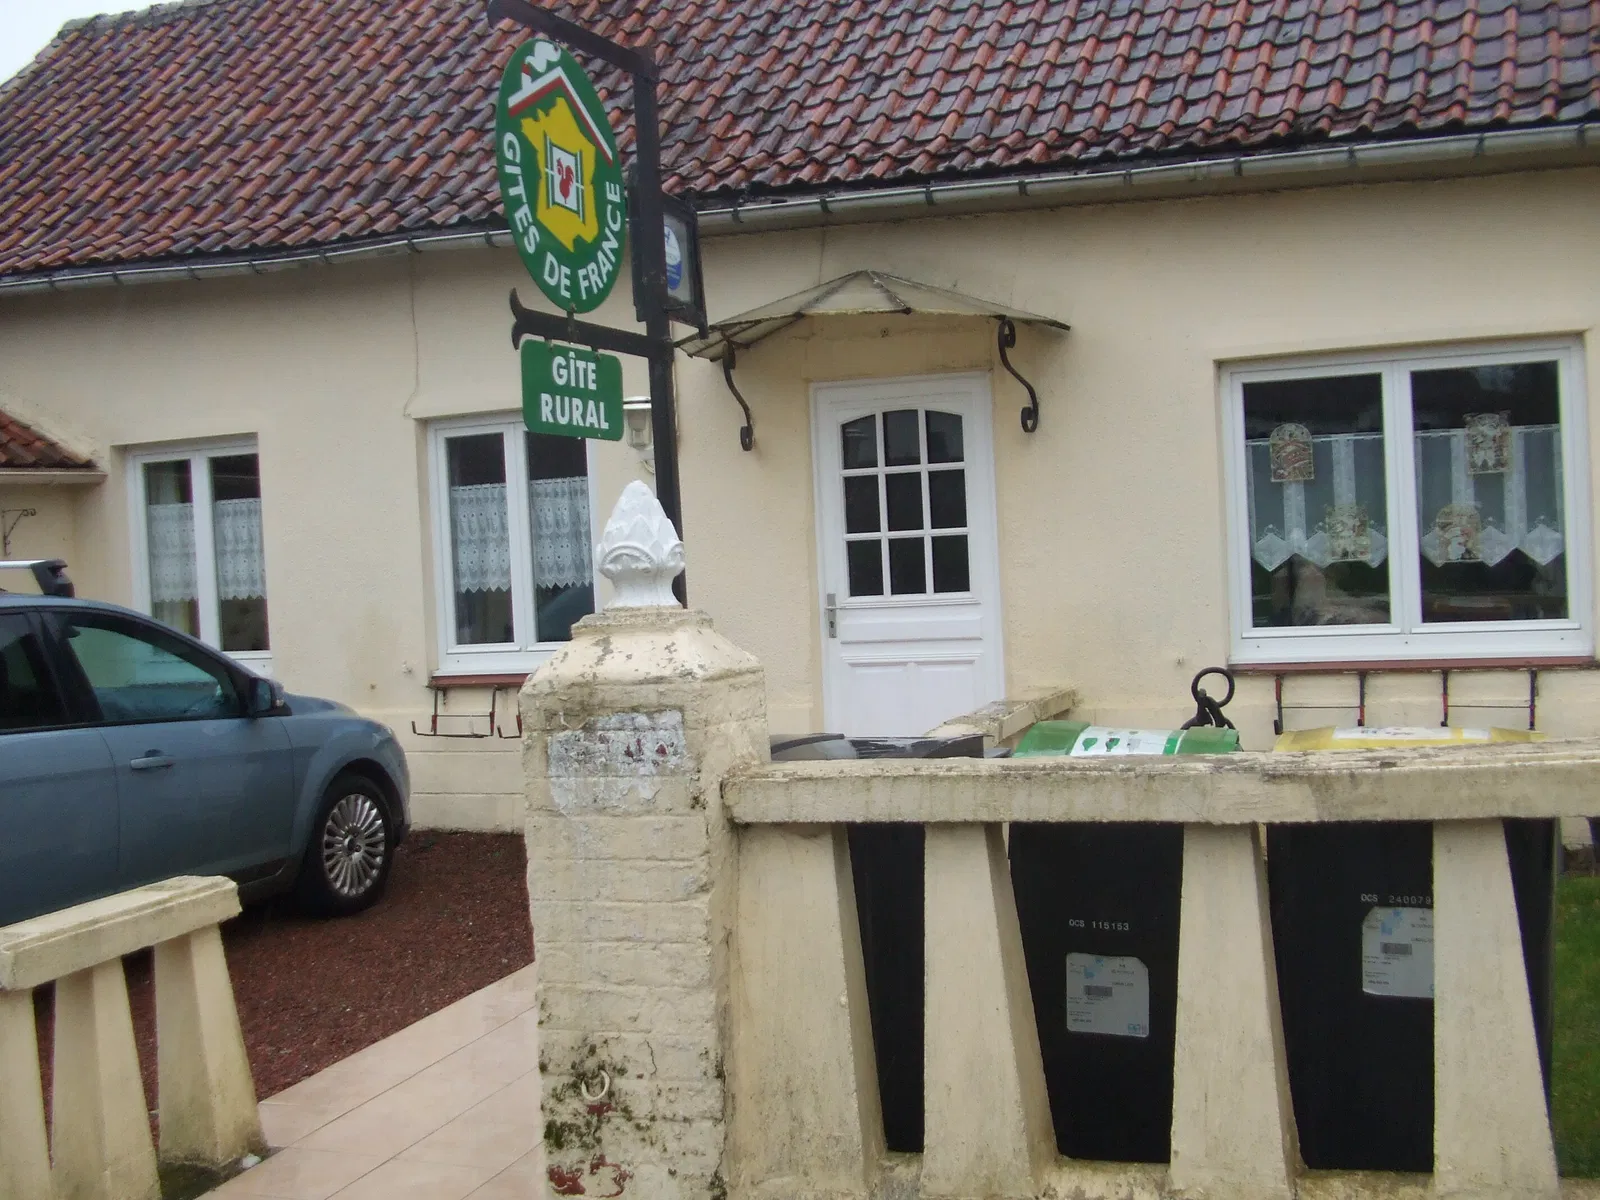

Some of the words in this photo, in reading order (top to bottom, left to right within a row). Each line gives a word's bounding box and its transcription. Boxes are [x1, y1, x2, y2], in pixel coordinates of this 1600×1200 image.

[503, 131, 540, 254] GITES
[543, 251, 572, 299] DE
[577, 181, 622, 300] FRANCE
[552, 351, 597, 391] GÎTE
[540, 392, 610, 430] RURAL
